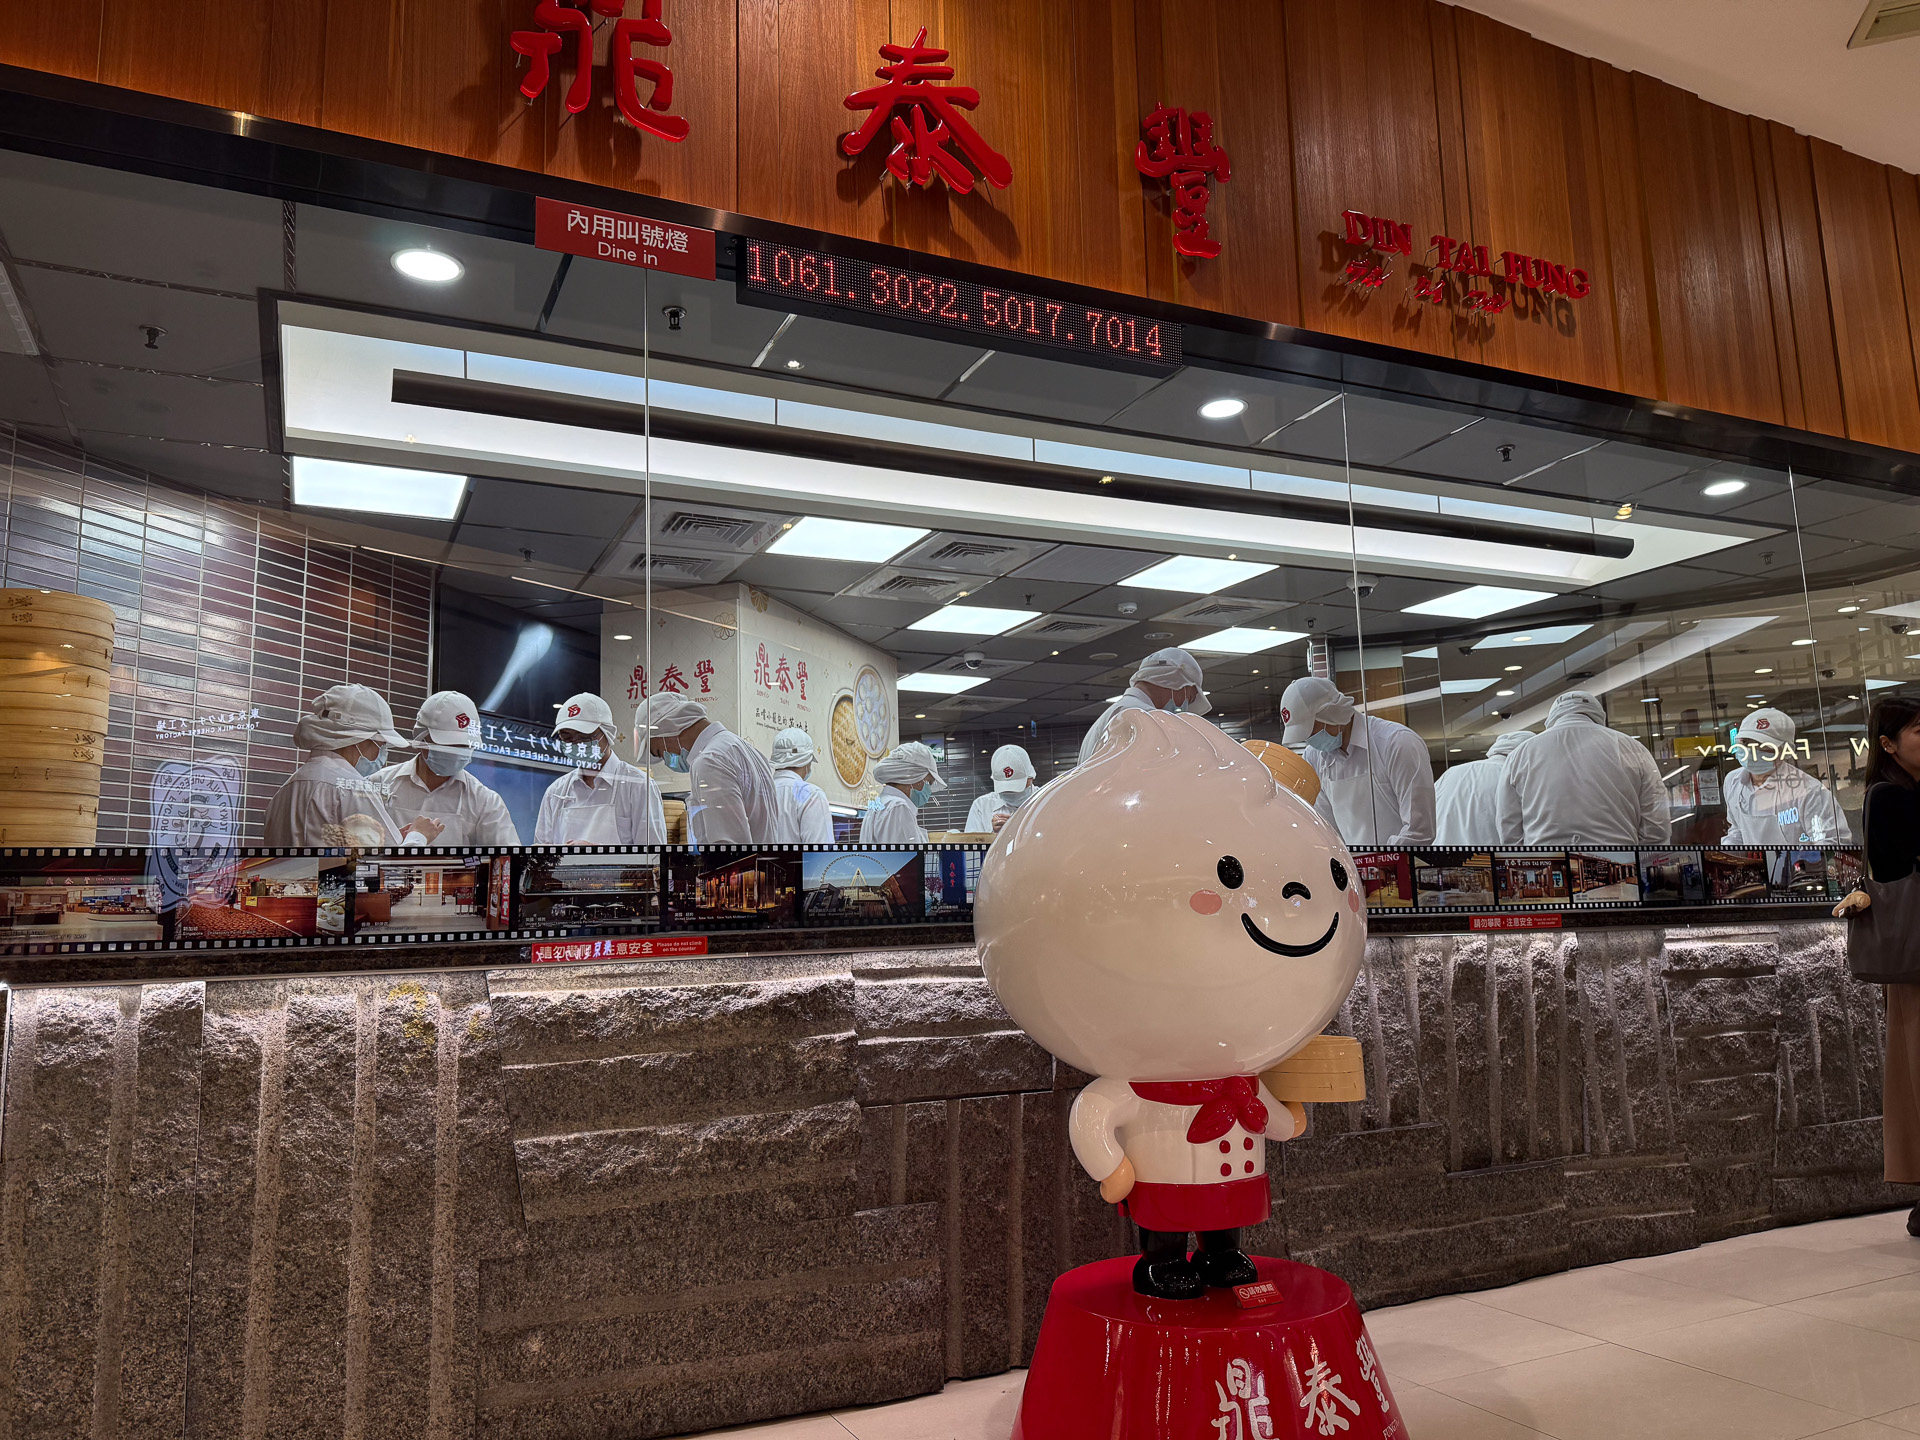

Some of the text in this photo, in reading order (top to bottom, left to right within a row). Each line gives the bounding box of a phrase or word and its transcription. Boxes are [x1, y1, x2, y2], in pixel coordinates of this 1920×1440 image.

[566, 209, 689, 254] 內用叫號燈
[597, 241, 659, 267] Dine in
[1341, 209, 1591, 299] DIN TAI FUNG
[626, 658, 715, 701] 鼎泰豐
[753, 642, 809, 701] 鼎泰豐
